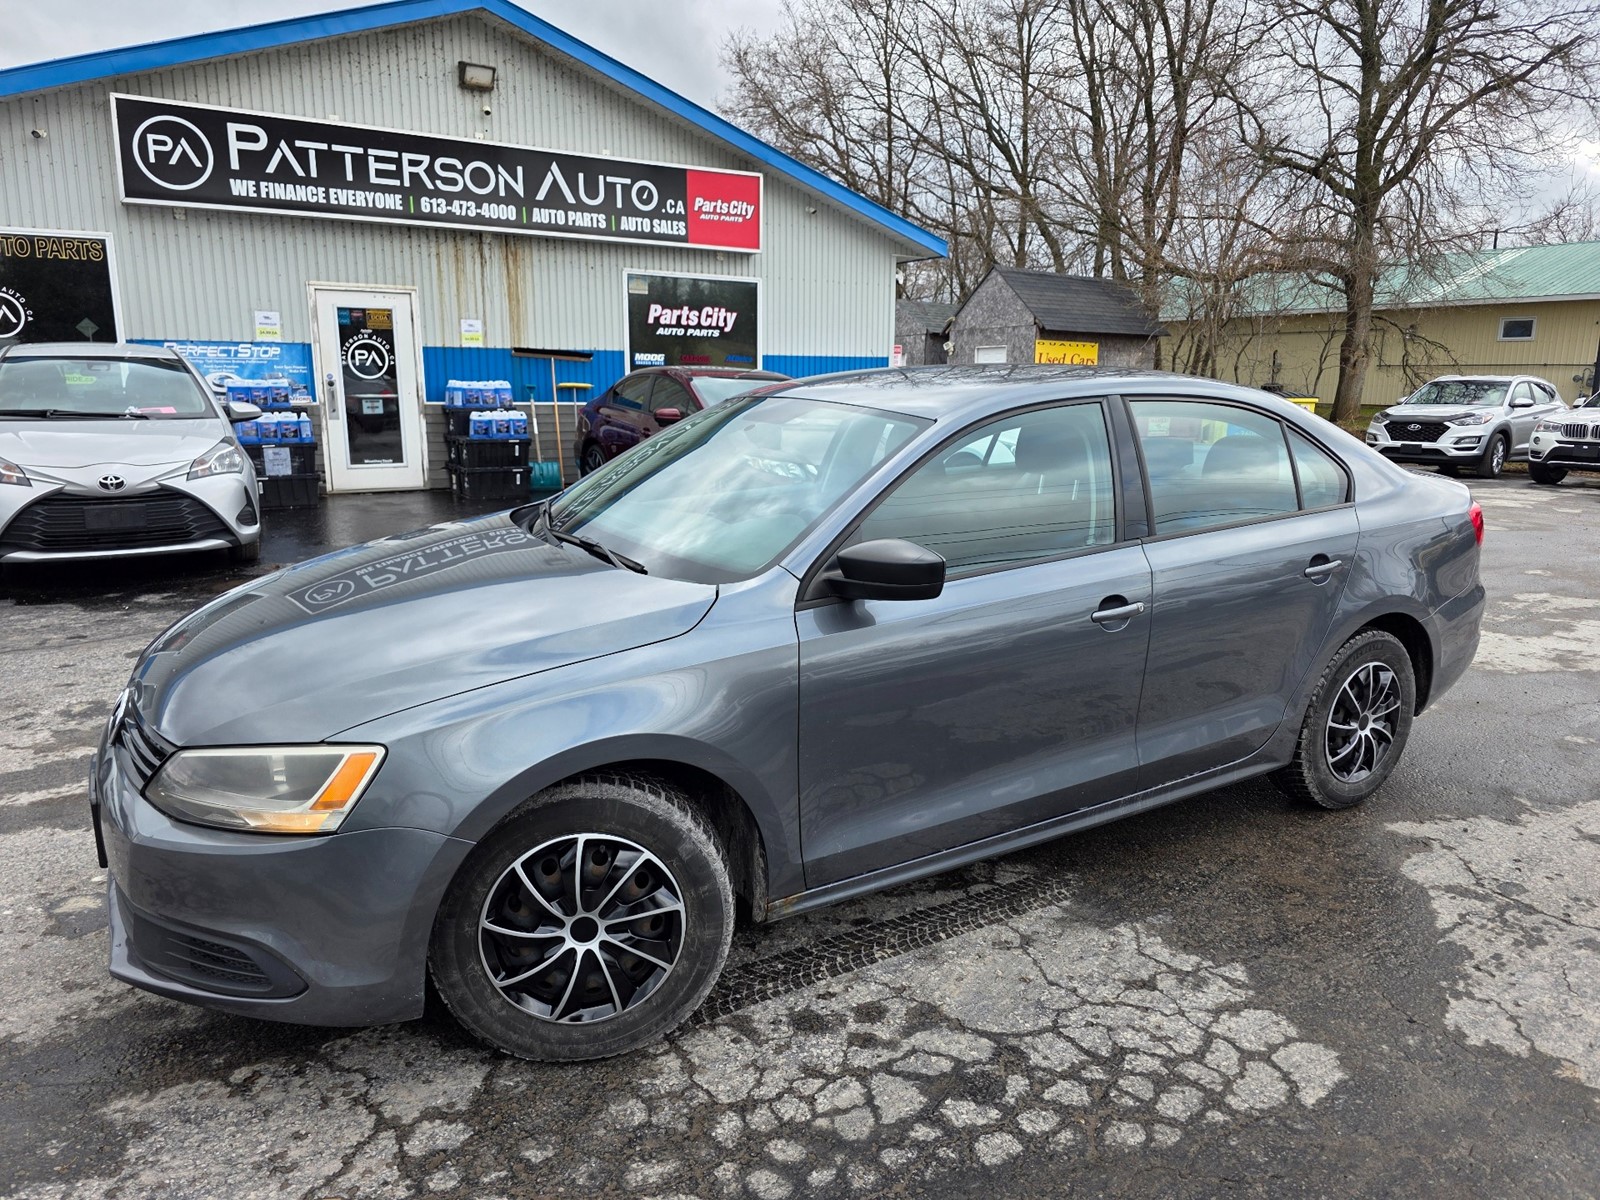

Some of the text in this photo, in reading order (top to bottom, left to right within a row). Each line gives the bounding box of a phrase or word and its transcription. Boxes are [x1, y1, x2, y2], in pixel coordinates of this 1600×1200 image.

[226, 122, 525, 199] PATTERSON
[229, 178, 403, 211] WE FINANCE EVERYONE
[420, 196, 517, 221] 613-473-4000
[532, 207, 607, 229] AUTO PARTS
[699, 213, 743, 223] AUTO PARTS
[620, 215, 687, 236] AUTO SALES
[35, 236, 104, 261] PARTS
[655, 327, 720, 337] AUTO PARTS
[354, 349, 384, 367] PA
[634, 352, 665, 361] MOOG
[1038, 352, 1096, 365] Used Cars
